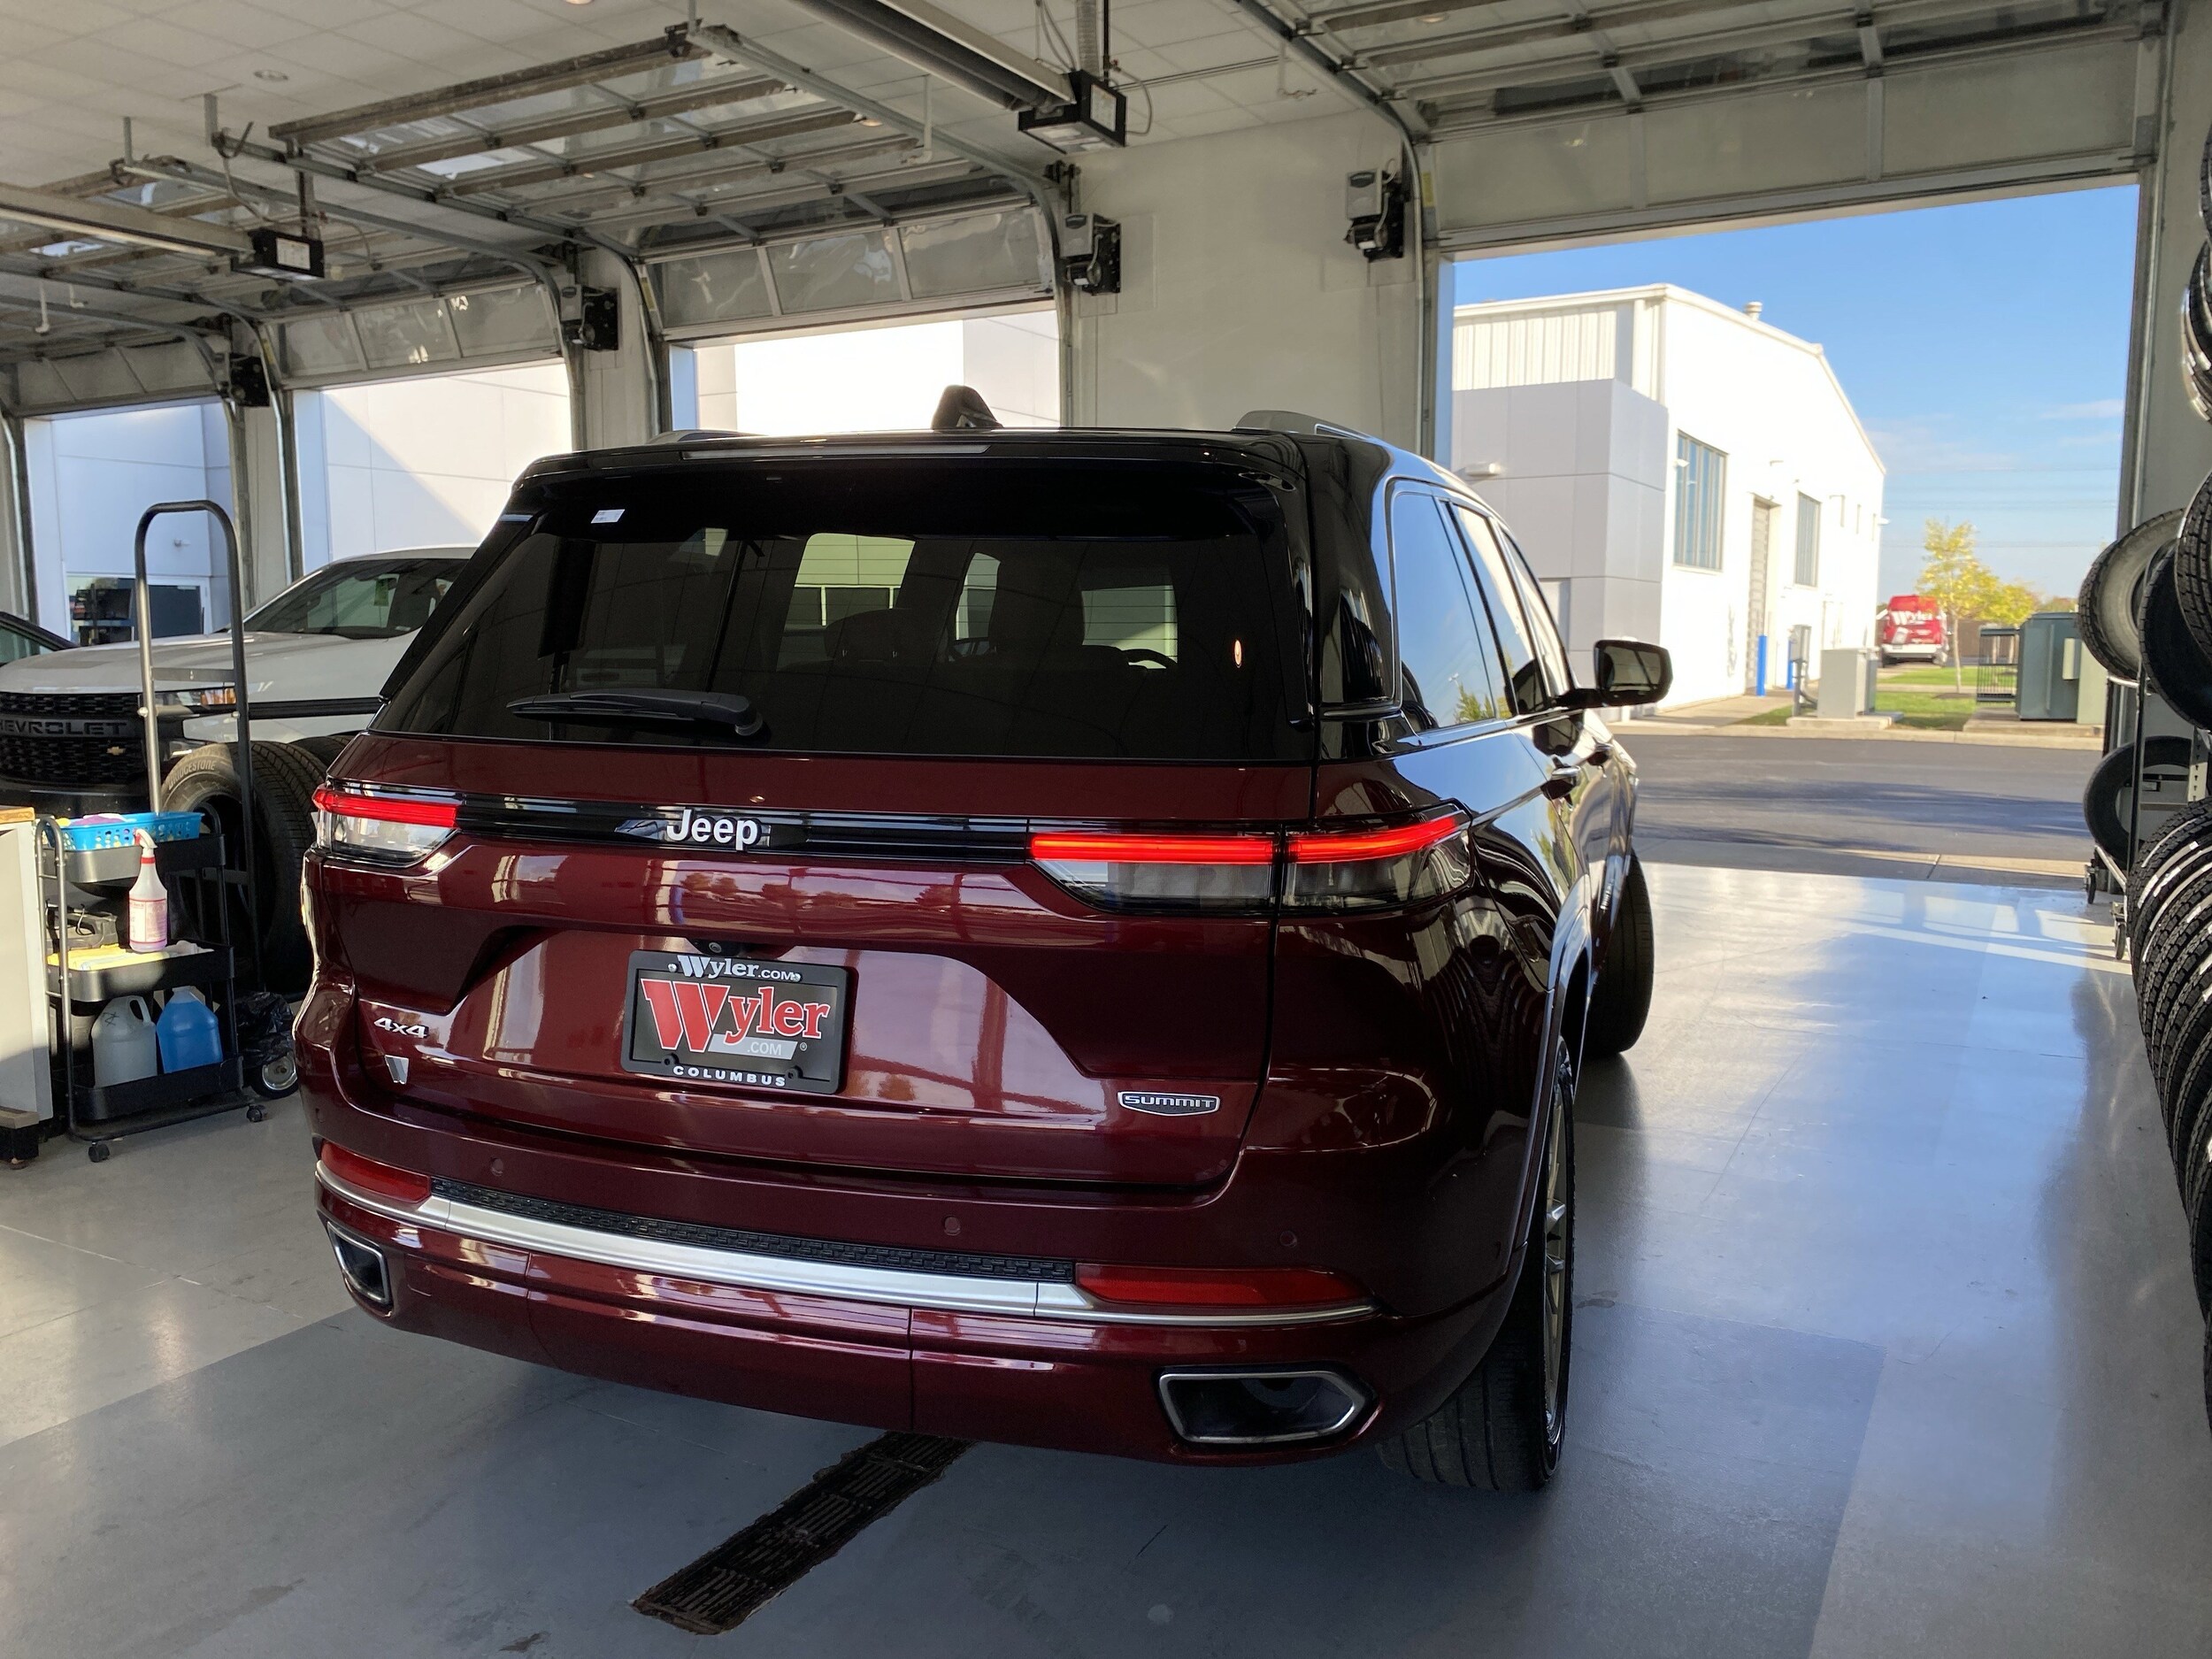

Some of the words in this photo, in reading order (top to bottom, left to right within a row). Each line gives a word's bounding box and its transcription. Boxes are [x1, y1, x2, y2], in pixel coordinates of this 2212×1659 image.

[666, 809, 759, 850] Jeep
[641, 978, 831, 1053] Wyler
[373, 1017, 428, 1039] 4x4
[747, 1041, 782, 1056] .COM
[672, 1064, 787, 1087] COLUMBUS
[1125, 1095, 1215, 1109] SUMMIT
